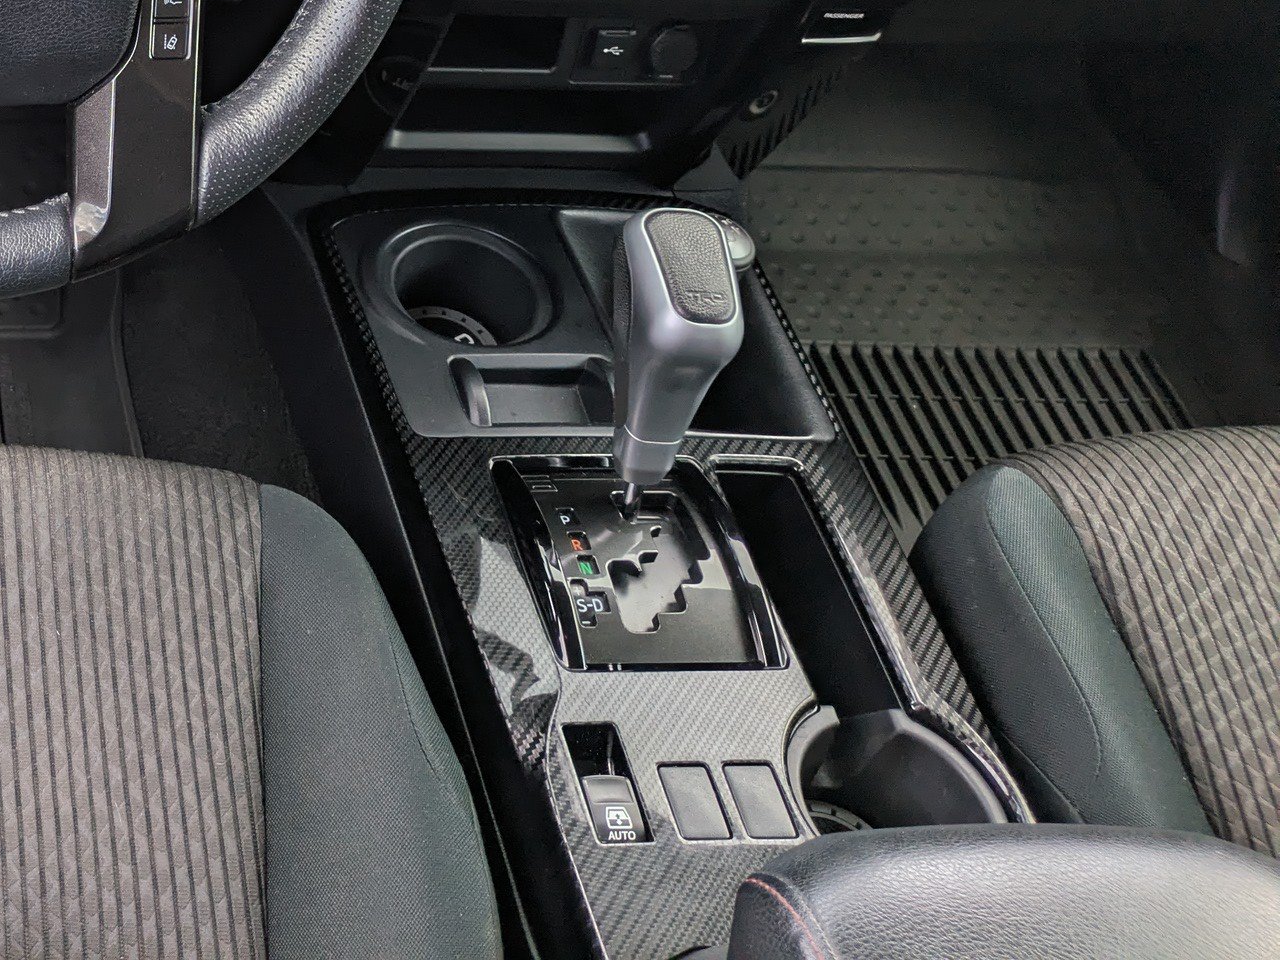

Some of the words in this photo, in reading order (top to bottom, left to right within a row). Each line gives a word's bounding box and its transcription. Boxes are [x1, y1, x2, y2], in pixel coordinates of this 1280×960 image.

[559, 514, 571, 525] P
[570, 539, 584, 551] R
[578, 561, 594, 575] N
[608, 830, 637, 841] AUTO
